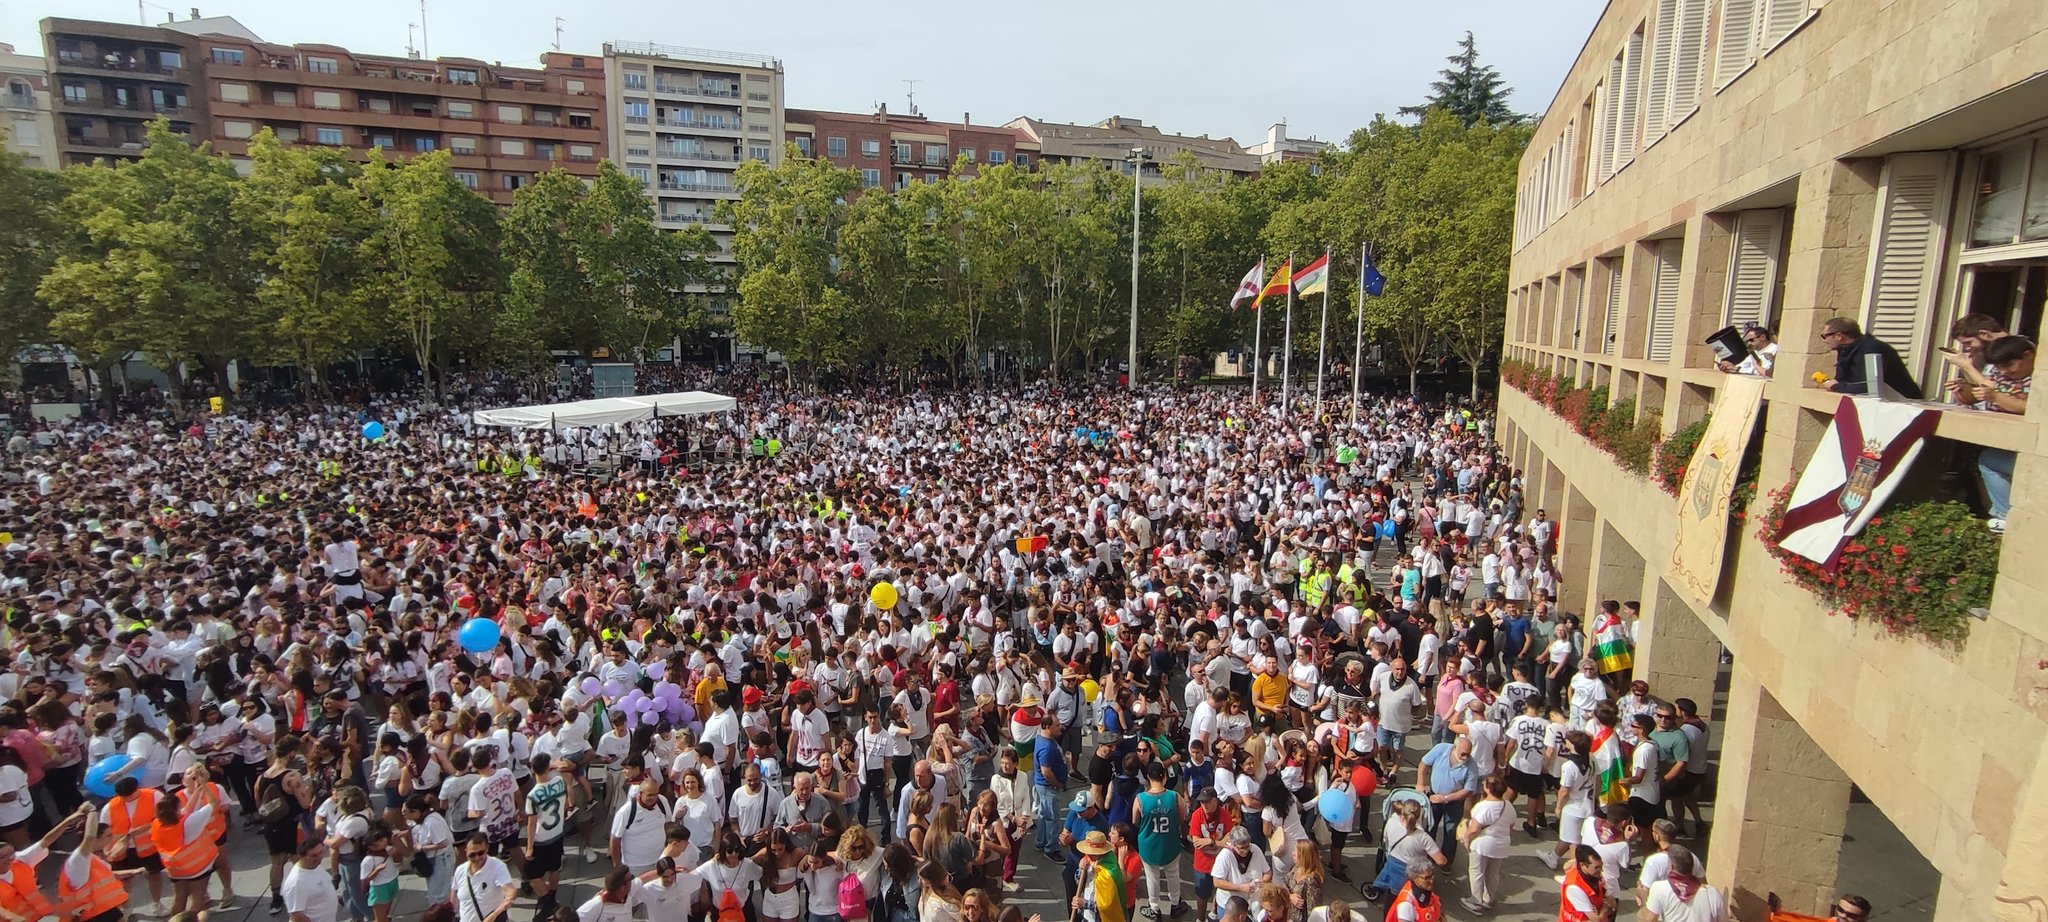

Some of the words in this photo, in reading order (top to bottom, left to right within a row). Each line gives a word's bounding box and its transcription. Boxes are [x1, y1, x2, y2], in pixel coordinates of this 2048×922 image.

[491, 793, 514, 822] 30
[541, 798, 561, 831] 3
[1152, 816, 1170, 834] 12
